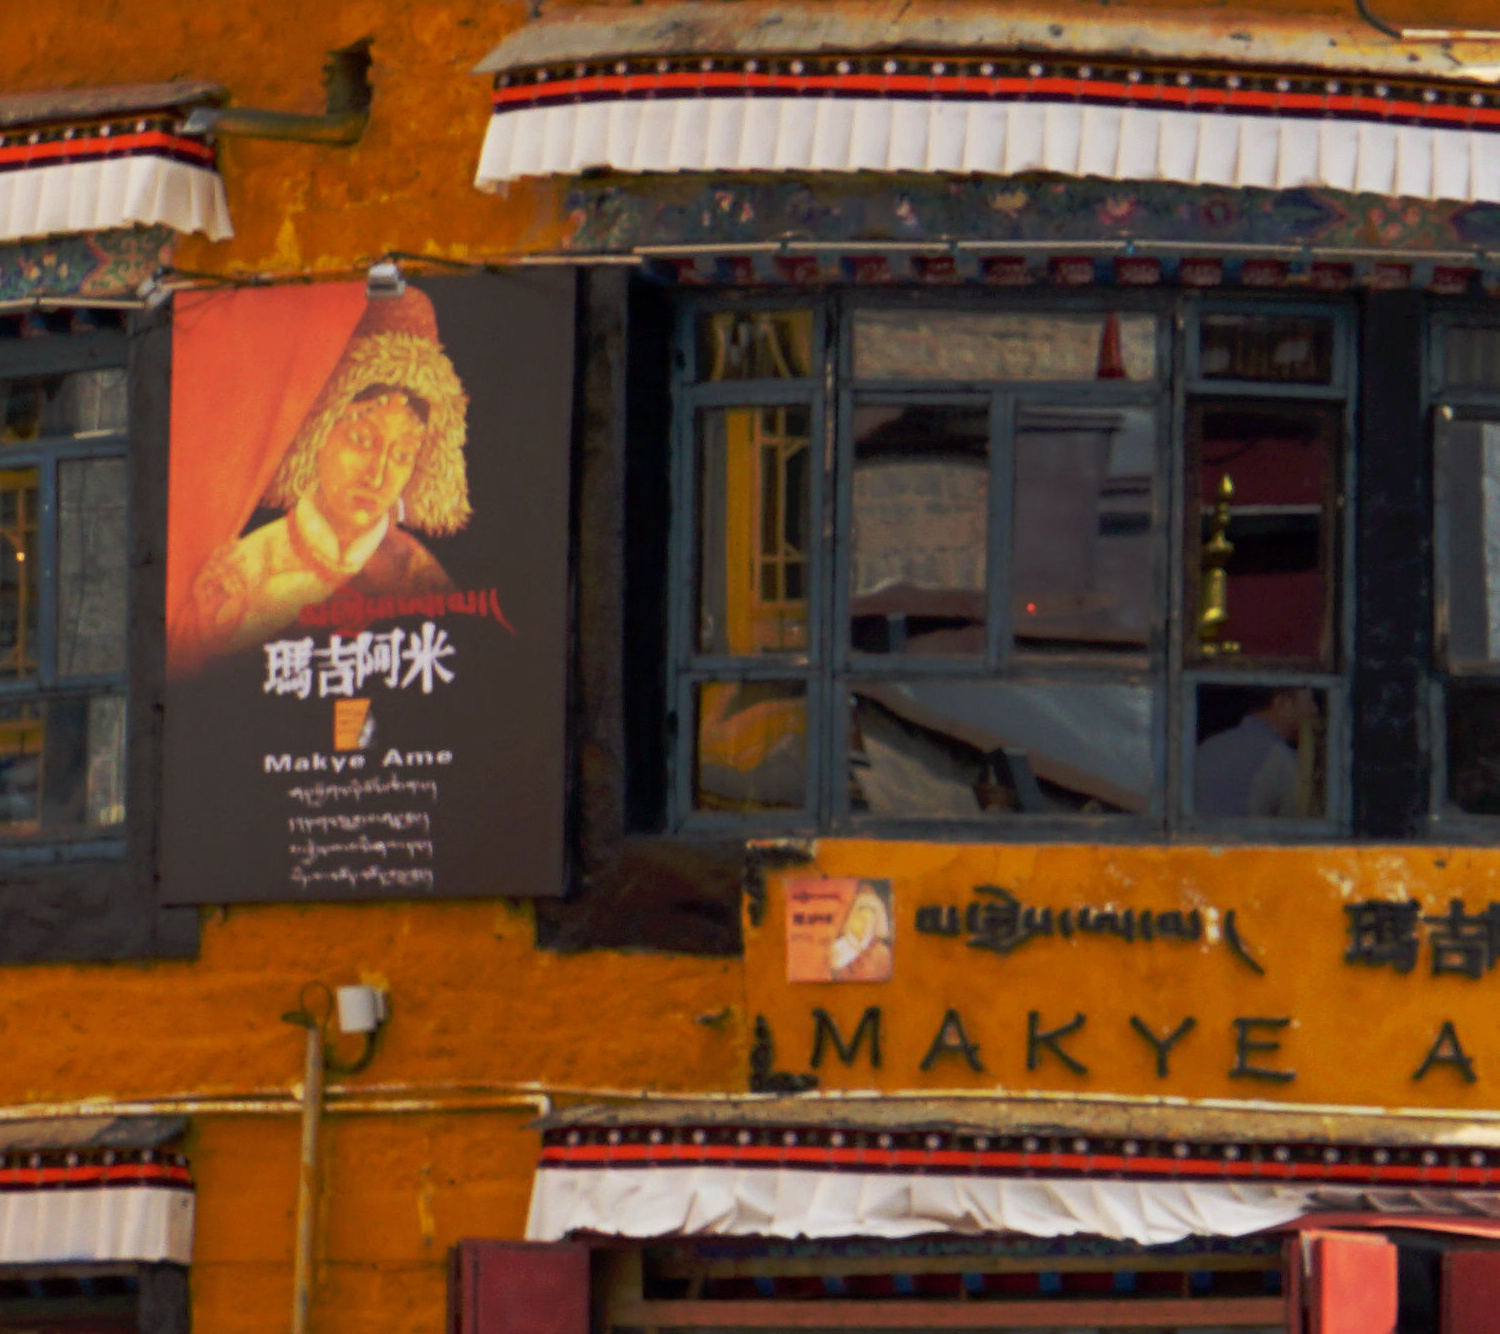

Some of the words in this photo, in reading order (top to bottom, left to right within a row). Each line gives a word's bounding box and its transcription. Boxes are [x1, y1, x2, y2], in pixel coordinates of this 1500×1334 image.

[263, 621, 456, 700] 瑪吉阿米
[263, 752, 366, 774] Makye
[382, 748, 454, 768] Ame
[810, 1005, 1297, 1085] MAKYE
